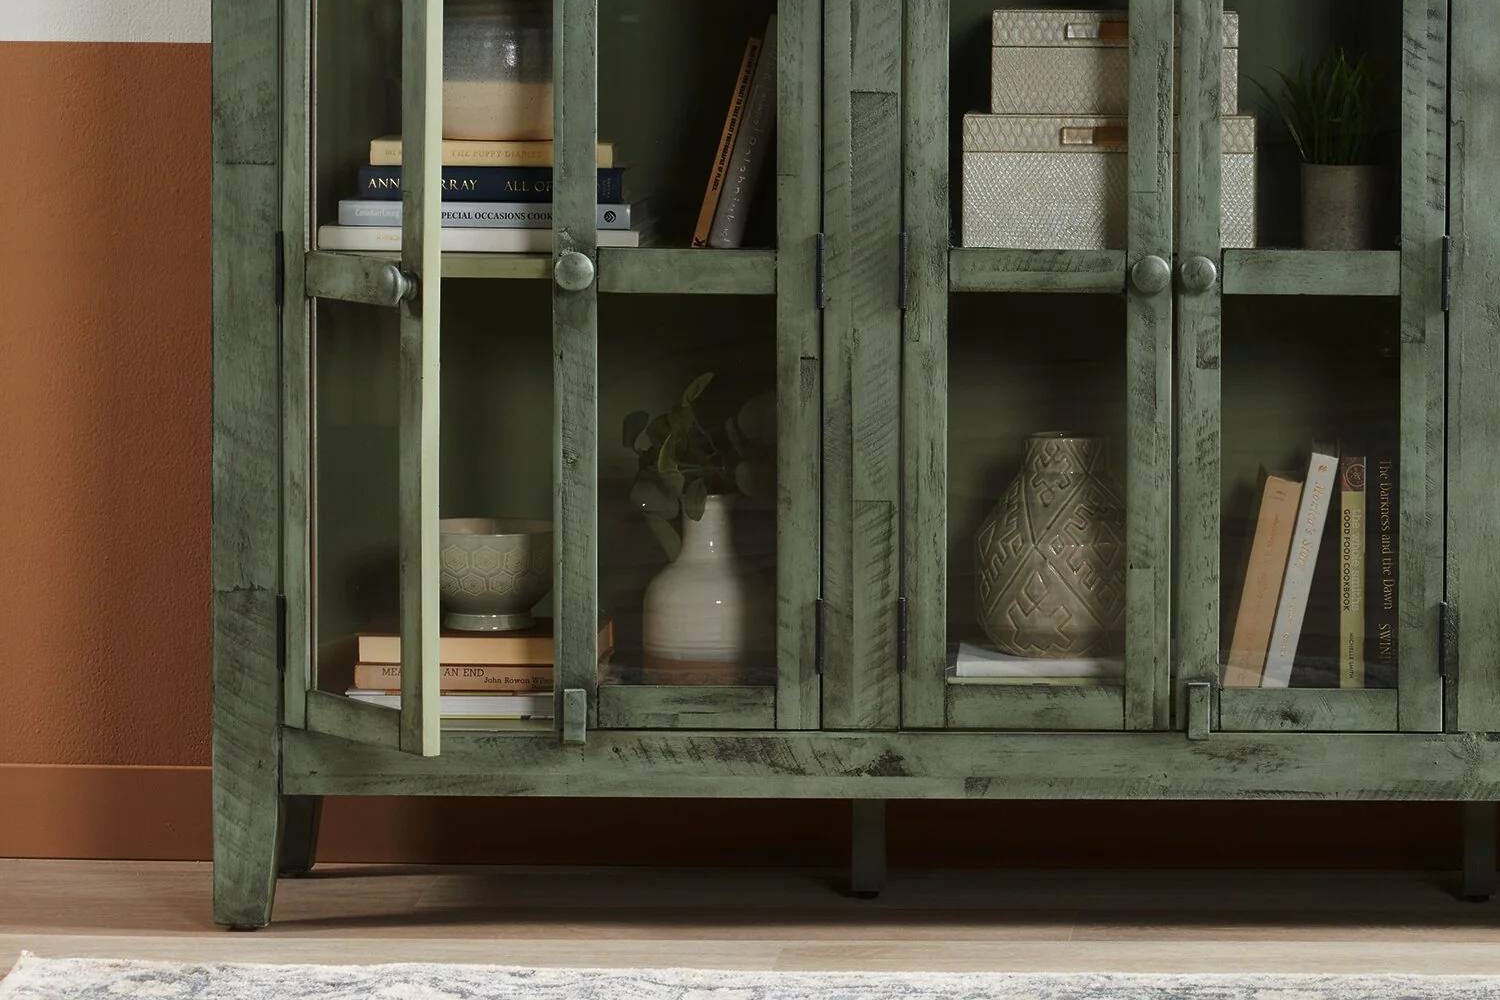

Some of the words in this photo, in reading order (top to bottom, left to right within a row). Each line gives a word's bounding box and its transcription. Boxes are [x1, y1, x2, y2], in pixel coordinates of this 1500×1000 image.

[473, 150, 502, 158] PUPPY
[504, 150, 542, 158] DIARIES
[368, 178, 400, 189] ANN
[441, 179, 477, 190] RRAY
[504, 180, 529, 191] ALL
[441, 212, 473, 220] PECIAL
[475, 212, 525, 220] OCCASIONS
[527, 213, 553, 221] COOK
[1379, 461, 1391, 479] The
[1380, 482, 1392, 531] Darkness
[1351, 509, 1361, 529] the
[1351, 532, 1361, 567] whole
[1382, 534, 1394, 554] and
[1382, 557, 1394, 576] the
[1351, 571, 1361, 611] smiths
[1383, 579, 1395, 610] Dawn
[382, 668, 400, 677] MEA
[443, 668, 459, 677] AN
[463, 668, 485, 677] END
[484, 676, 502, 684] John
[532, 676, 553, 684] Wilso
